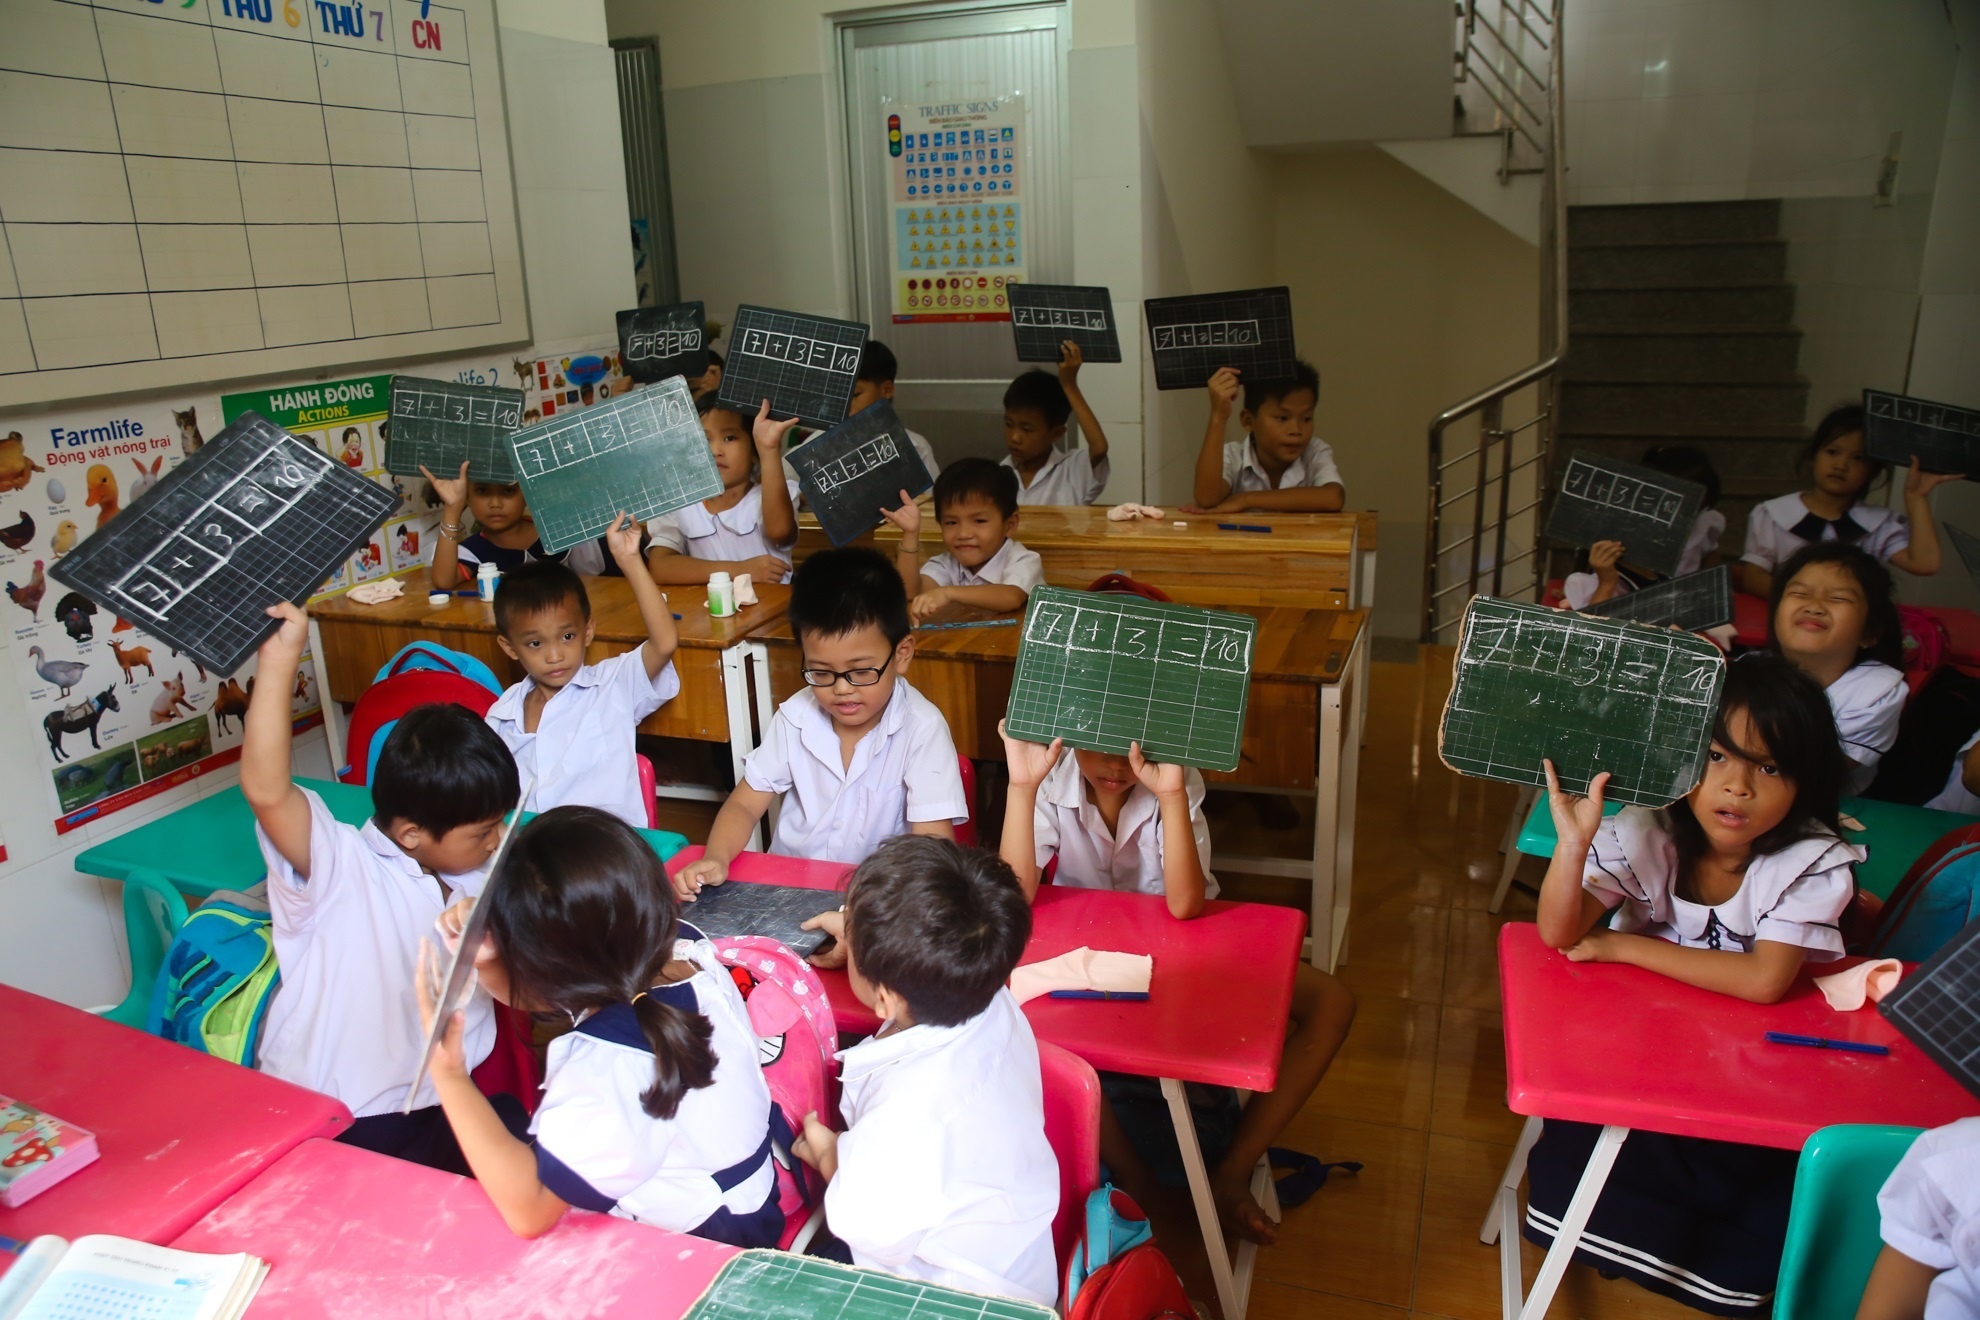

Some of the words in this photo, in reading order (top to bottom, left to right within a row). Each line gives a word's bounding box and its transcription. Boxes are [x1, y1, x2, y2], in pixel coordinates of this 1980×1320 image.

[283, 0, 300, 28] 6
[369, 10, 384, 41] 7
[412, 19, 441, 51] CN
[919, 104, 964, 117] TRAFFIC
[966, 101, 999, 113] SIGNS
[751, 333, 761, 352] 7
[794, 342, 807, 361] 3
[837, 353, 857, 370] 10
[269, 390, 321, 412] HÀNH
[324, 382, 375, 405] ĐỘNG
[402, 400, 414, 414] 7
[452, 405, 464, 422] 3
[497, 409, 517, 425] 10
[298, 405, 349, 423] ACTIONS
[50, 419, 144, 448] Farmlife
[530, 449, 546, 472] 7
[599, 424, 615, 449] 3
[659, 398, 682, 427] 10
[46, 450, 86, 466] Động
[89, 446, 111, 460] vật
[113, 442, 147, 456] nông
[149, 435, 171, 450] trại
[132, 582, 171, 602] 7
[205, 523, 232, 545] 3
[275, 463, 305, 488] 10
[1042, 611, 1063, 640] 7
[1124, 627, 1147, 656] 3
[1211, 636, 1239, 661] 10
[1476, 627, 1511, 667] 7
[1573, 645, 1600, 687] 3
[1683, 667, 1716, 690] 10
